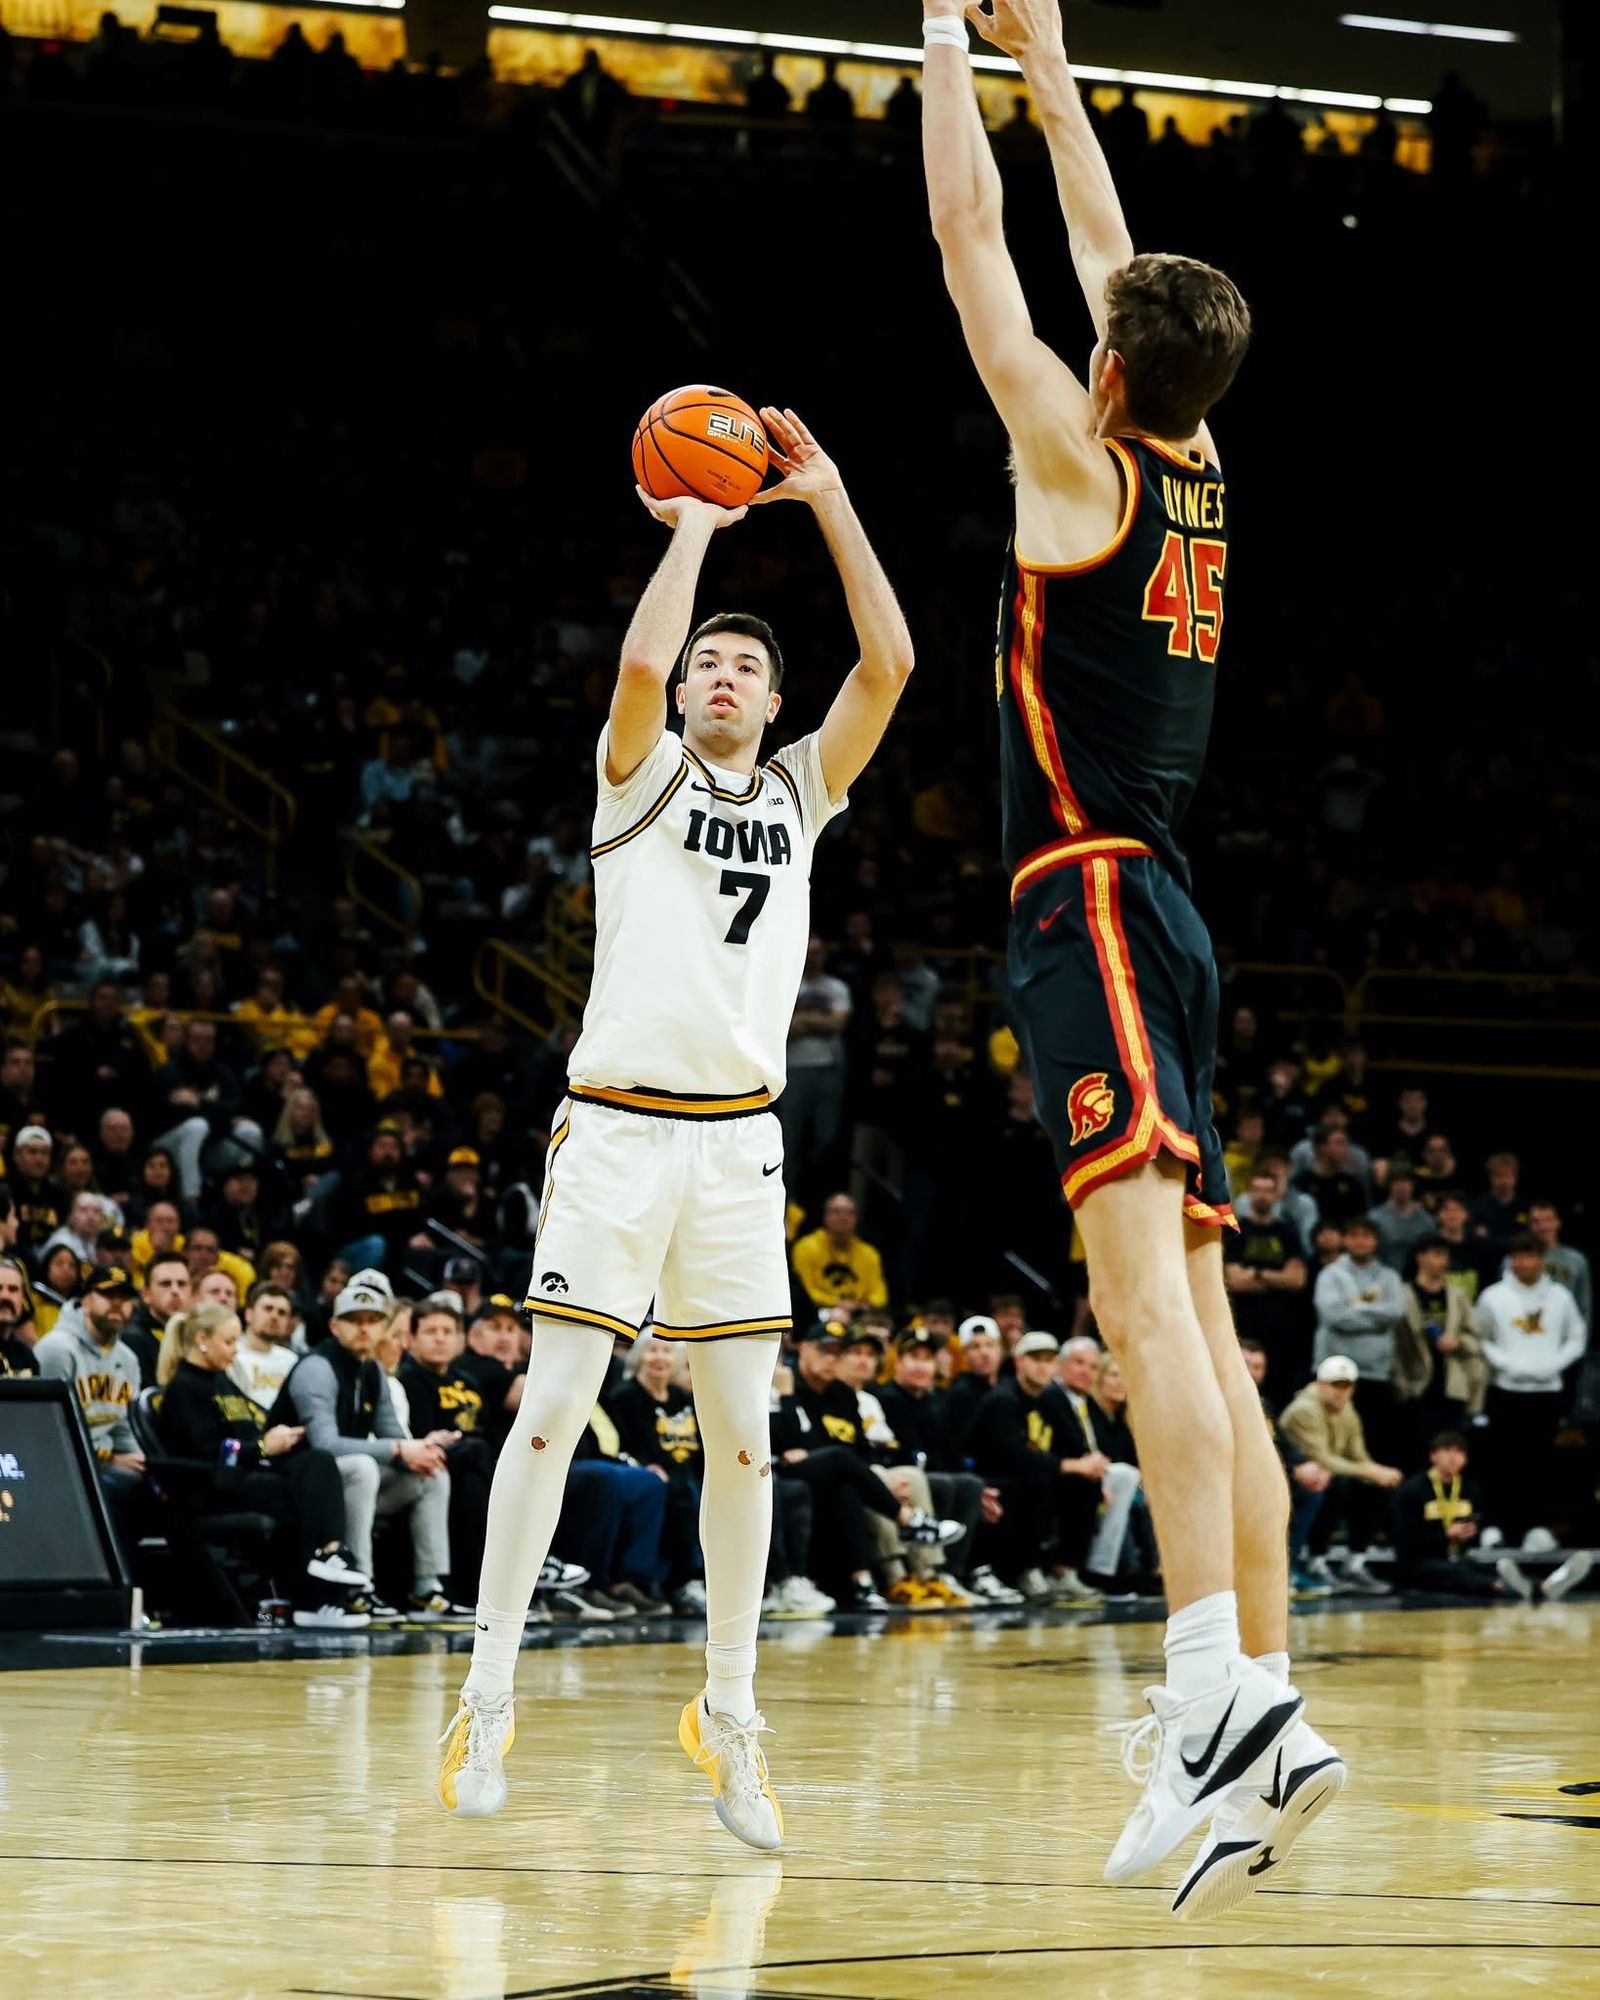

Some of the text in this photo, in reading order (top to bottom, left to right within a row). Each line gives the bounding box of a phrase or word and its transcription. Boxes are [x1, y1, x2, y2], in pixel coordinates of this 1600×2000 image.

[709, 412, 765, 456] ELITE
[1162, 474, 1226, 530] DYNES
[1141, 529, 1227, 664] 45
[684, 809, 791, 865] IOWA
[719, 870, 770, 945] 7
